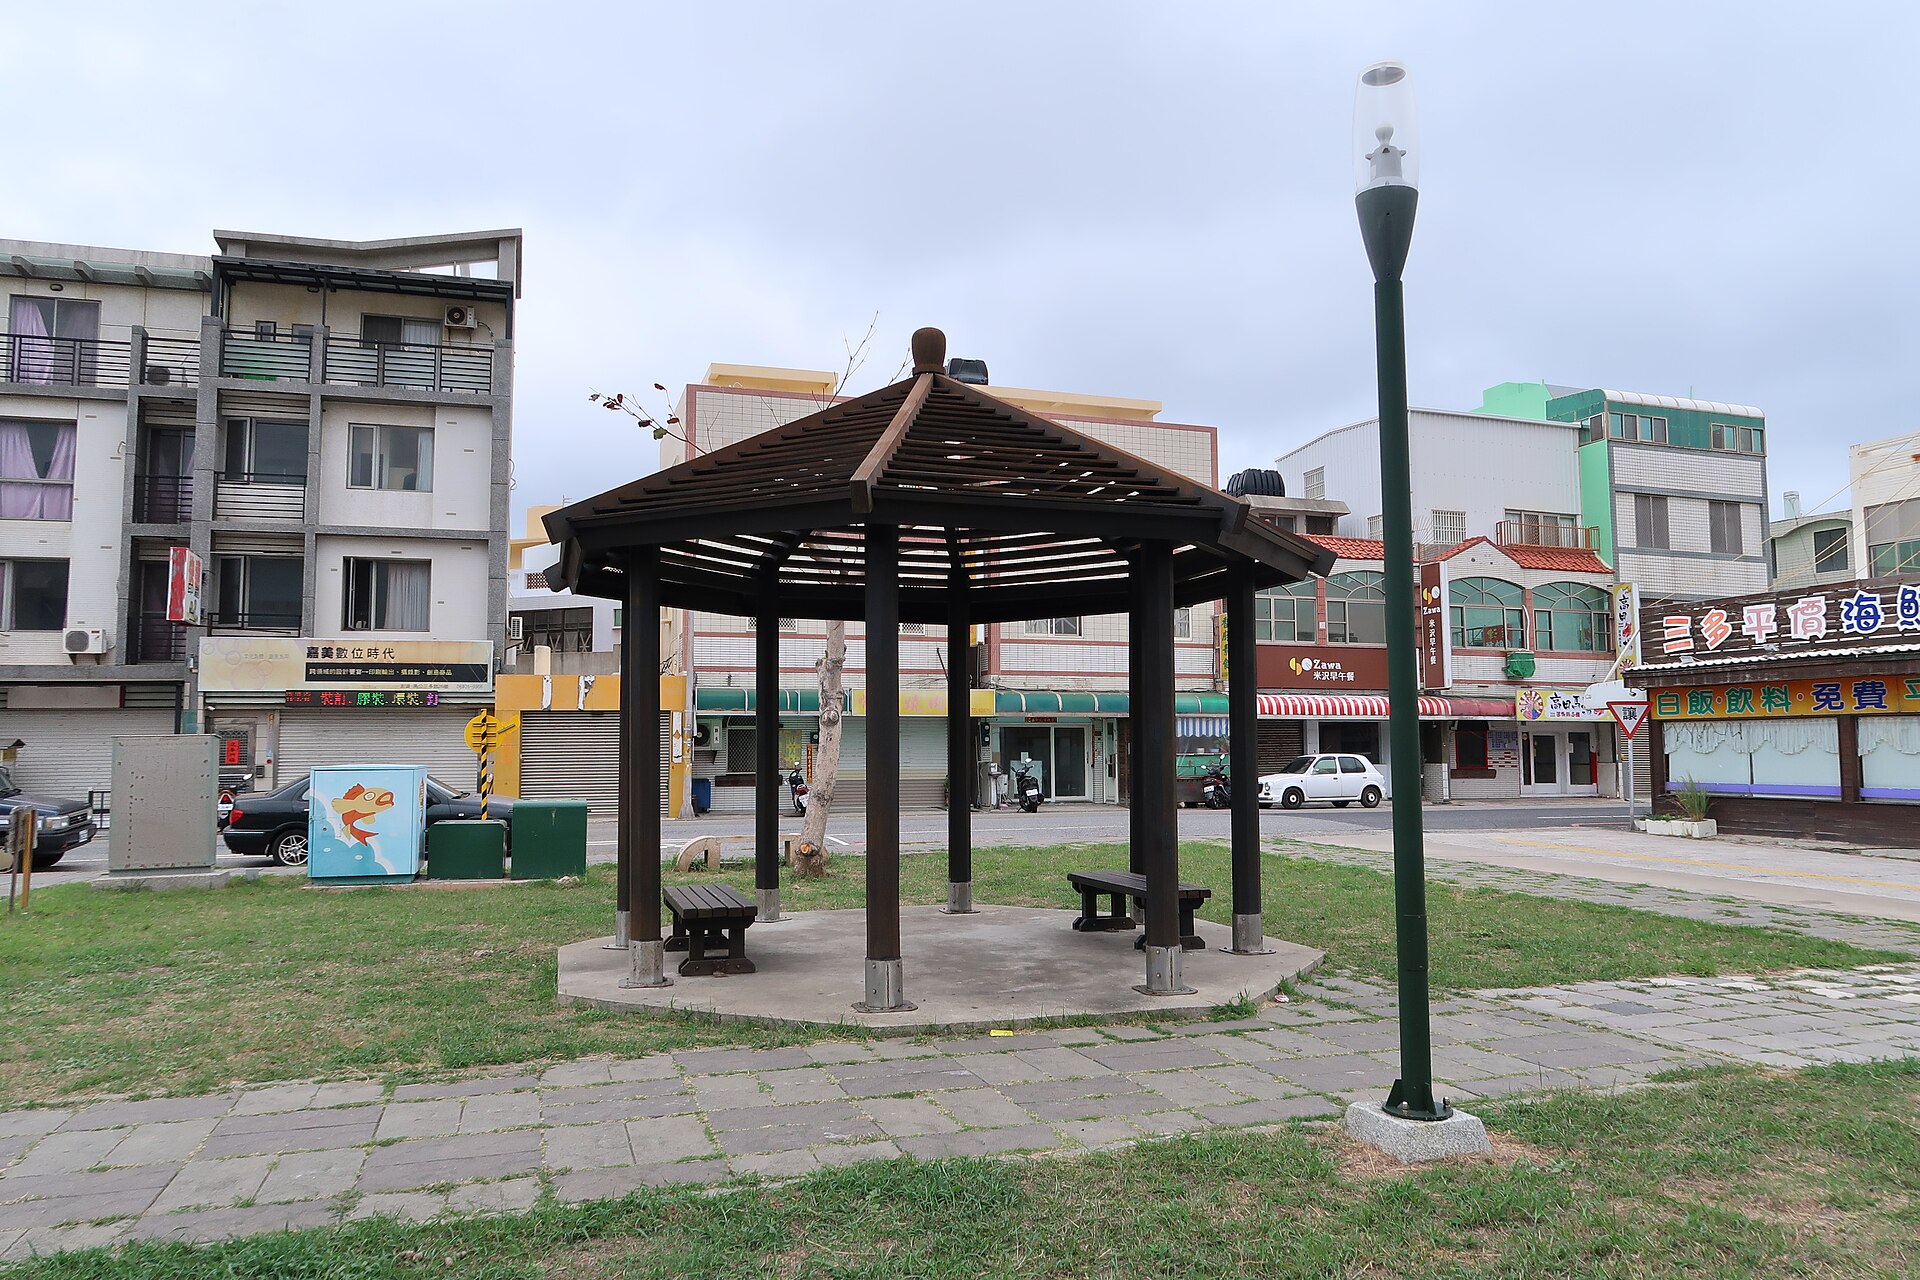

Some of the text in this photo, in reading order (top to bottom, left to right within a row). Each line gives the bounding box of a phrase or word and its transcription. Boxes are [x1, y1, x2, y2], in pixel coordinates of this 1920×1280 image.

[1423, 606, 1441, 615] Zawa
[306, 646, 395, 660] 嘉美數位時代
[1313, 659, 1342, 670] Zawa
[1313, 671, 1355, 682] 米沢早午餐
[1622, 706, 1638, 721] 讓
